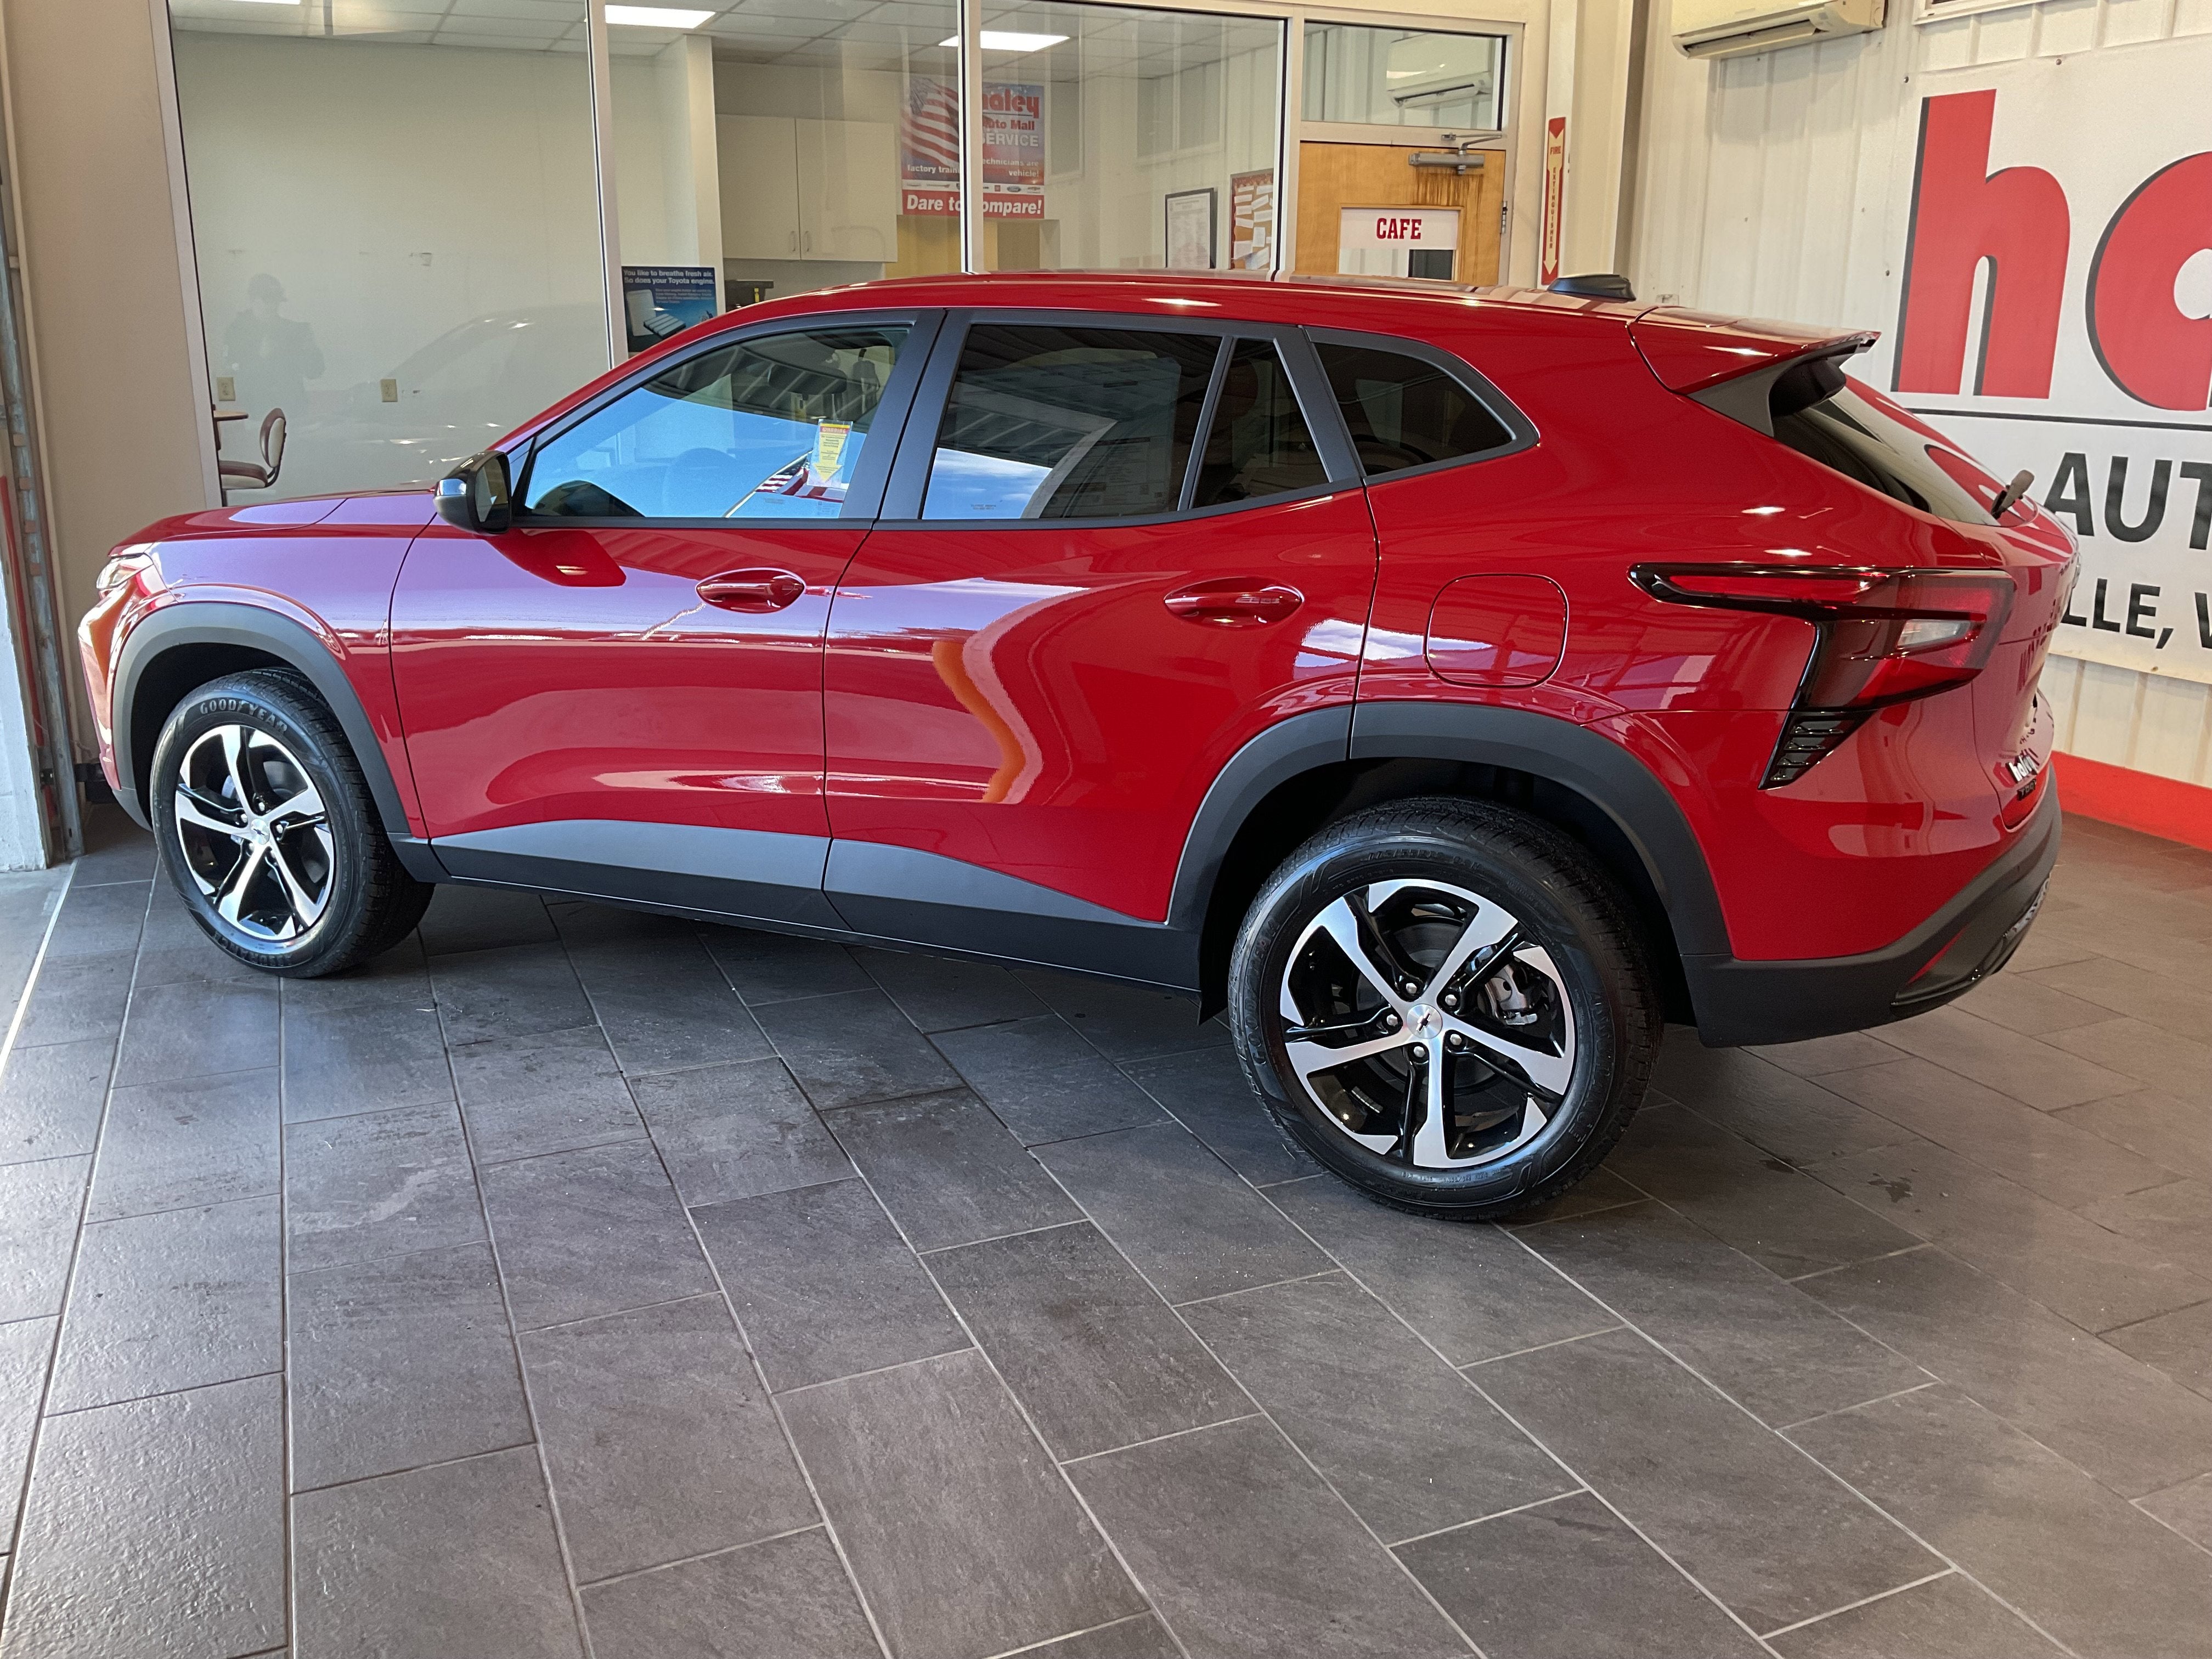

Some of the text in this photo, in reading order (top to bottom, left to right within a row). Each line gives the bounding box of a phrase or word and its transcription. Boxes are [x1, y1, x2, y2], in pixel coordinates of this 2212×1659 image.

[1011, 120, 1035, 131] Mall
[1550, 146, 1561, 155] FIRE
[983, 157, 1024, 166] echnicians
[907, 165, 936, 174] factory
[907, 194, 944, 211] Dare
[983, 200, 1042, 216] ompare!
[1376, 218, 1422, 239] CAFE
[668, 277, 690, 285] Toyota
[200, 699, 288, 734] GOODYEAR
